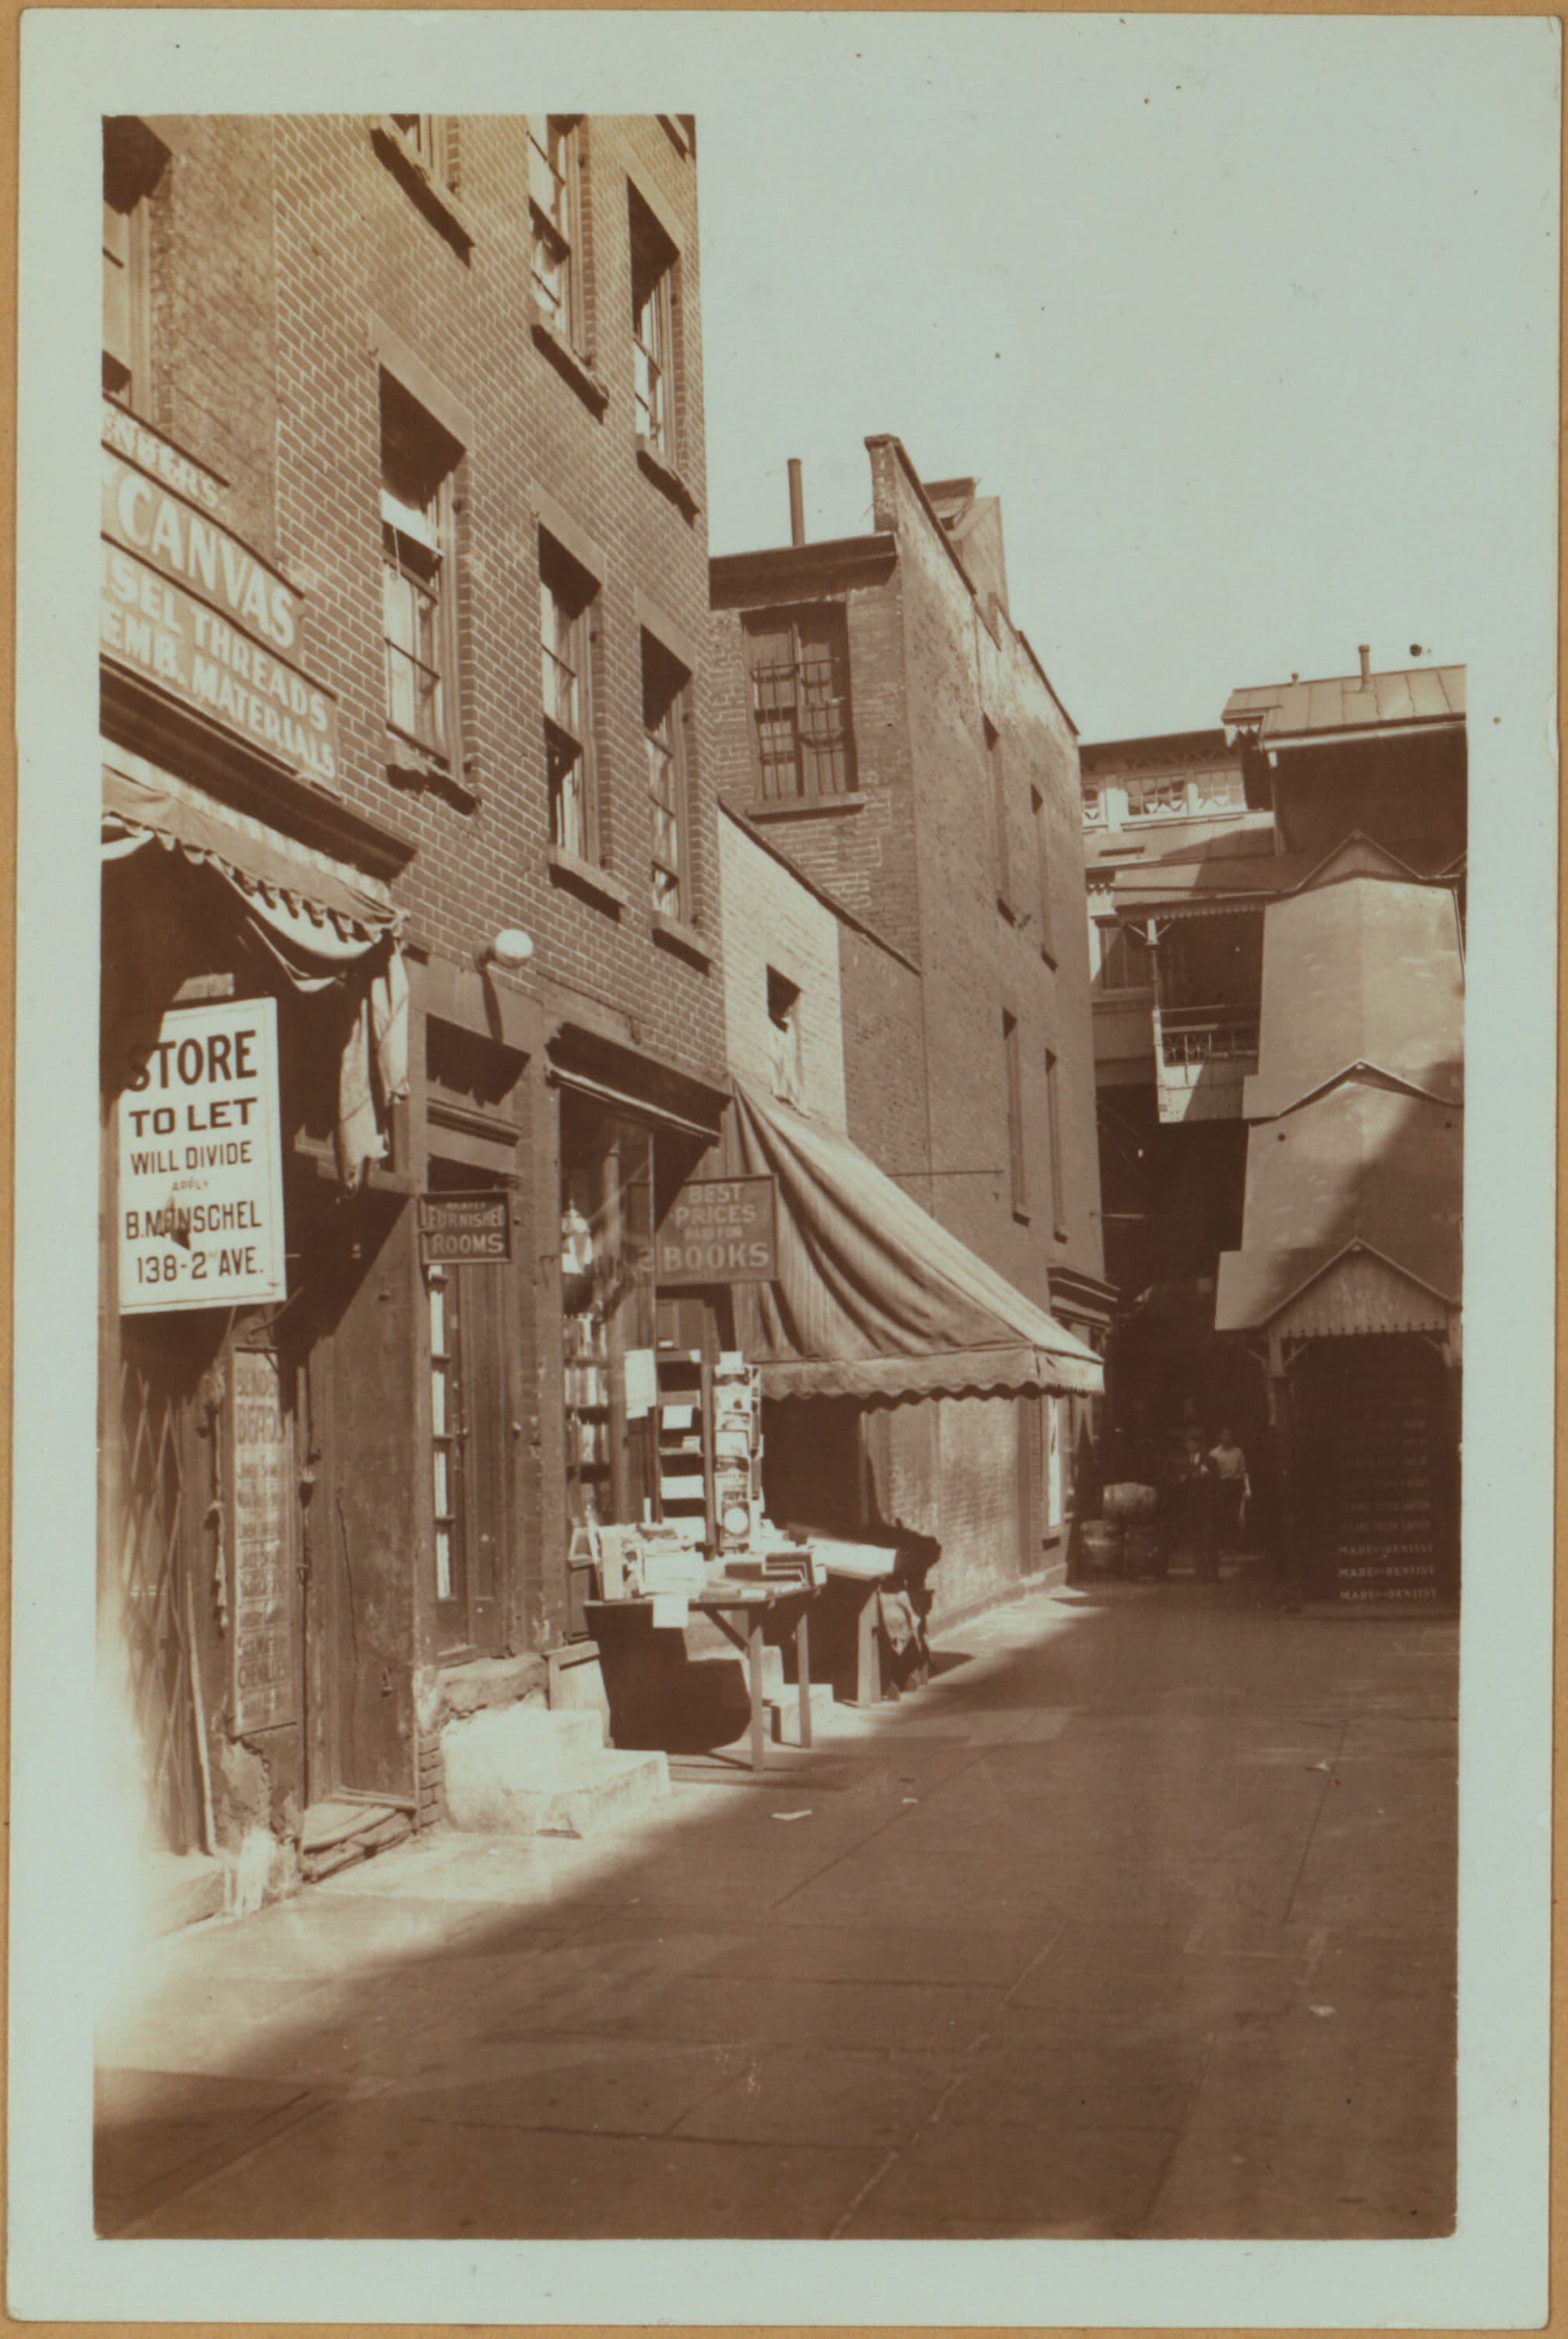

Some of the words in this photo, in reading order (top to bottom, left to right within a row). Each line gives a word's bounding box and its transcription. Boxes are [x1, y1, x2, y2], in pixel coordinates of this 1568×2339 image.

[118, 473, 294, 648] CANVAS
[103, 550, 181, 638] SEL
[190, 602, 329, 732] THREADS
[192, 653, 337, 780] MATERIALS
[129, 1029, 258, 1092] STORE
[129, 1110, 176, 1138] TO
[187, 1097, 258, 1132] LET
[131, 1149, 180, 1176] WILL
[185, 1141, 252, 1170] DIVIDE
[171, 1180, 210, 1191] APPLY
[689, 1184, 743, 1205] BEST
[674, 1205, 756, 1226] PRICES
[432, 1233, 505, 1254] ROOMS
[717, 1225, 743, 1239] FOR
[219, 1245, 264, 1277] AVE.
[663, 1241, 770, 1272] BOOKS
